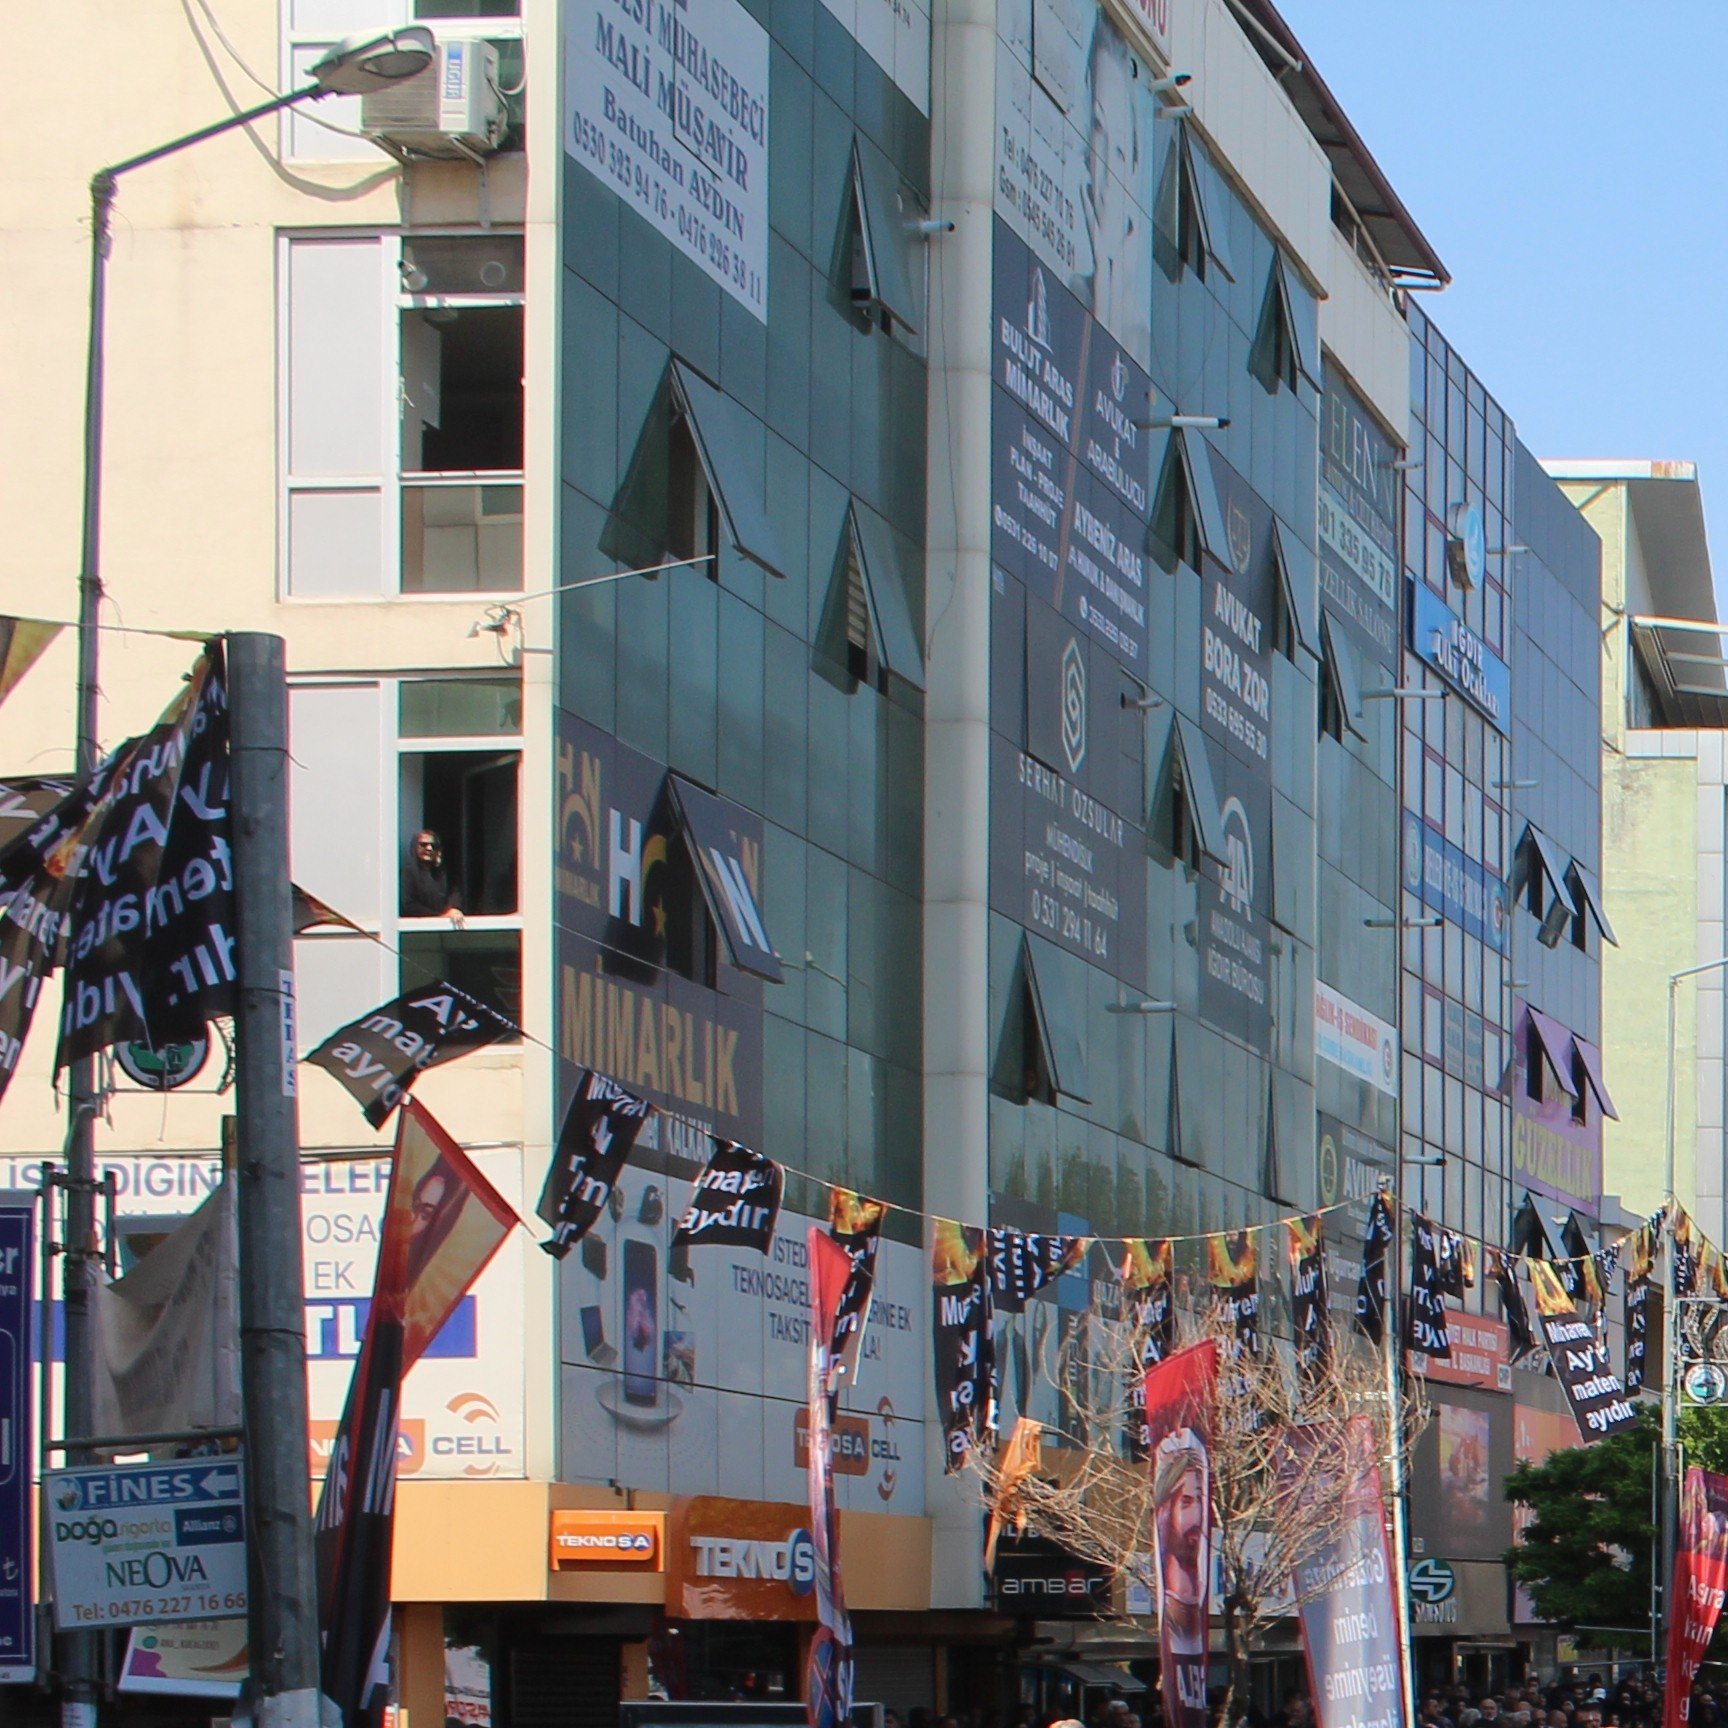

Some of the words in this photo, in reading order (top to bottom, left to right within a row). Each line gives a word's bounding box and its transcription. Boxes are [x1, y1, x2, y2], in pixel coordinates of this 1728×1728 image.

[595, 12, 651, 99] MALİ
[602, 85, 685, 187] Batuhan
[572, 110, 606, 167] 0530
[634, 163, 651, 206] 94
[653, 181, 668, 221] 76
[678, 203, 708, 257] 0476
[1001, 316, 1042, 377] BULUT
[1043, 360, 1073, 408] ARAS
[1005, 357, 1070, 443] MİMARLIK
[1096, 389, 1138, 449] AVUKAT
[1214, 581, 1263, 655] AVUKAT
[1204, 626, 1242, 698] BORA
[1243, 661, 1270, 723] ZOR
[1018, 752, 1067, 808] SERHAT
[561, 953, 740, 1115] MİMARLIK
[731, 1263, 812, 1310] TEKNOSACEL
[432, 1435, 513, 1456] CELL
[87, 1472, 195, 1505] FİNES
[55, 1513, 119, 1546] Doğa
[183, 1518, 221, 1534] Allianz
[556, 1534, 652, 1551] TEKNOSA
[105, 1550, 208, 1589] NEOVA
[689, 1535, 815, 1582] TEKNOS
[72, 1602, 104, 1622] Tel:
[108, 1600, 154, 1619] 0476
[158, 1596, 192, 1616] 227
[197, 1594, 220, 1612] 16
[223, 1591, 248, 1610] 66
